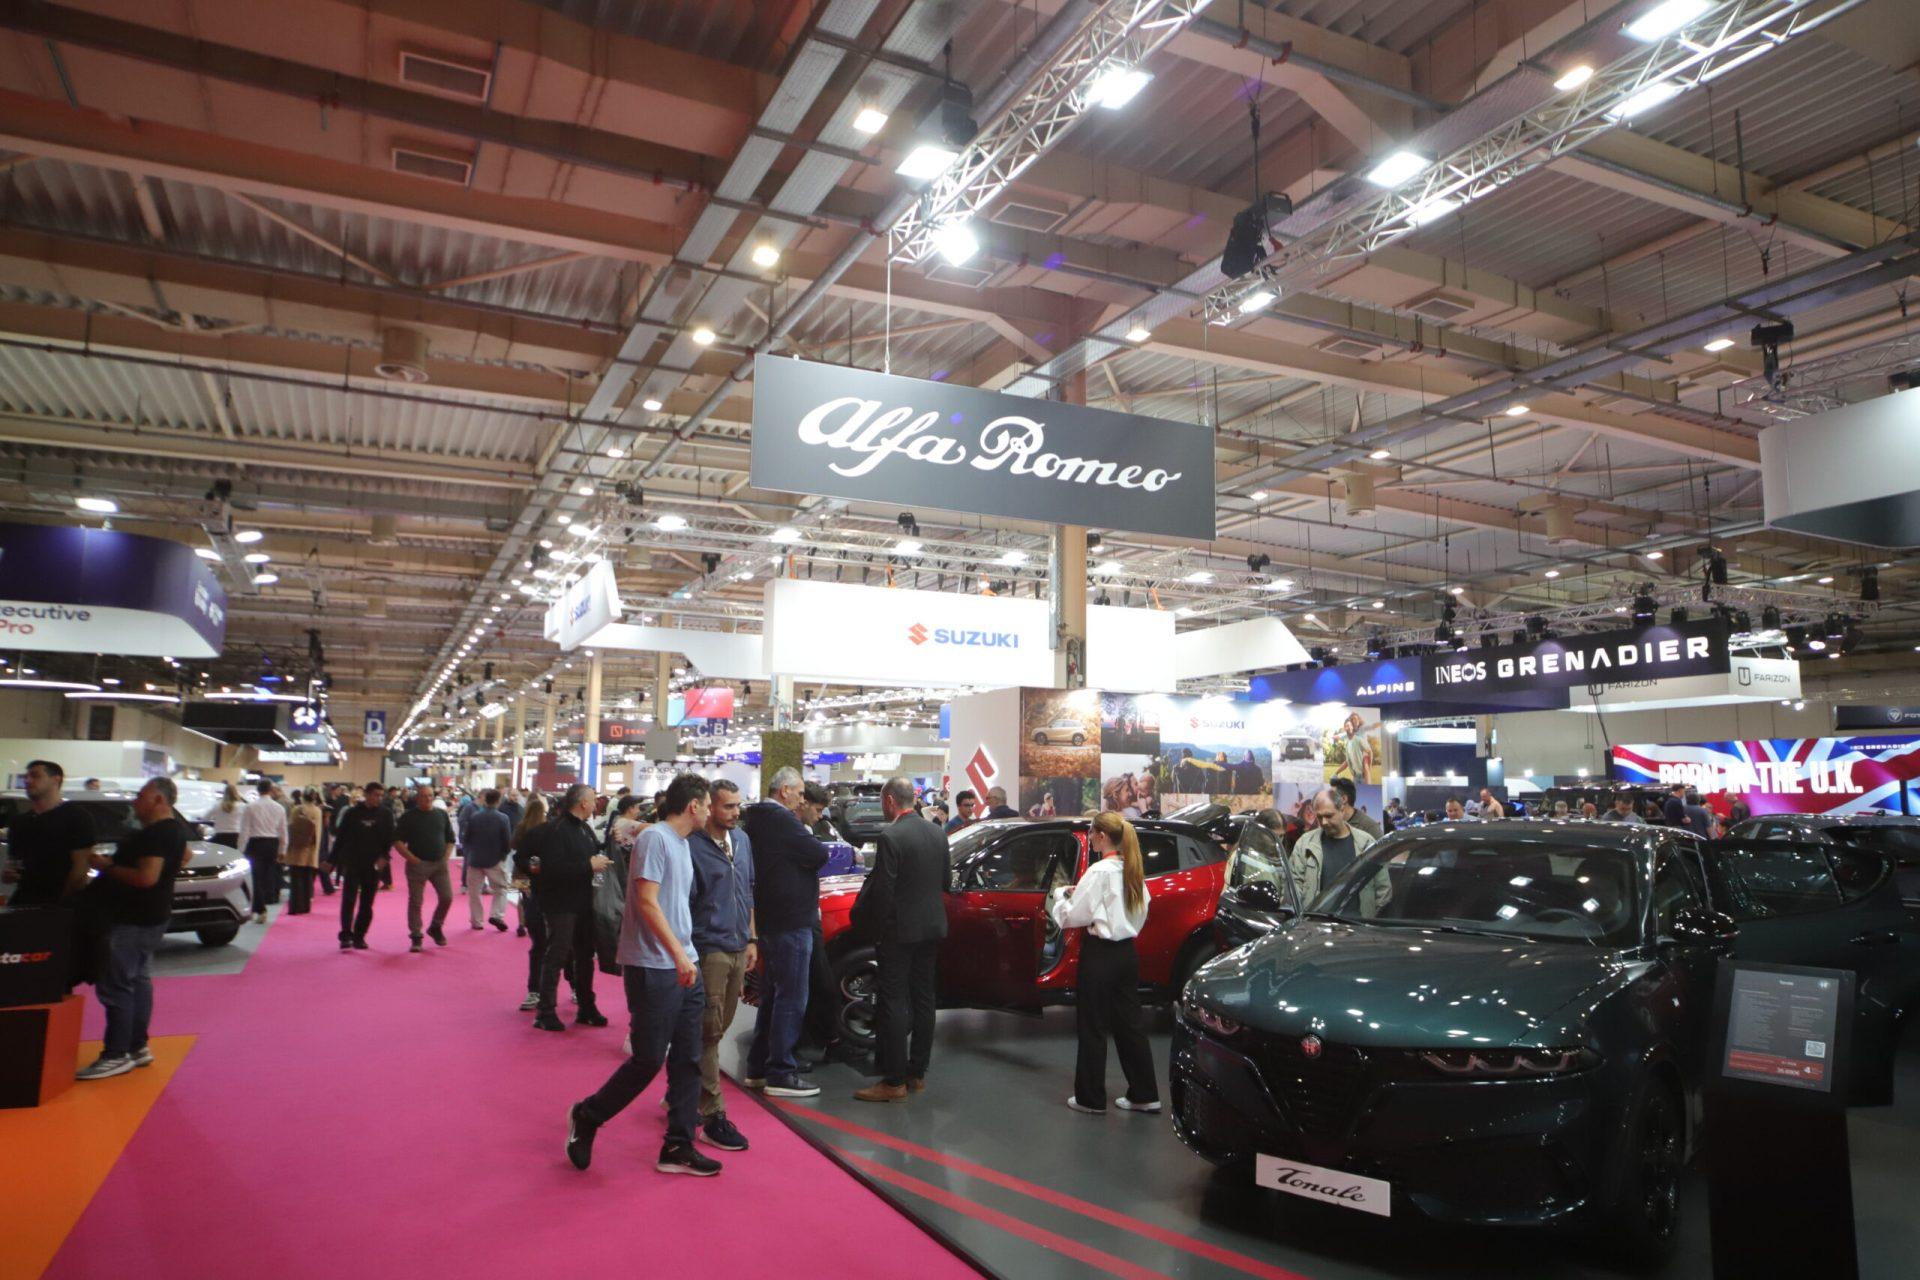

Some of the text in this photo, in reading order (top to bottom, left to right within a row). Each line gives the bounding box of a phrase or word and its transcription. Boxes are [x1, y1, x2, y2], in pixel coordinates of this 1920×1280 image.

[798, 396, 1182, 492] Alfa Romeo
[0, 604, 91, 621] ecutive
[934, 628, 1019, 648] SUZUKI
[1435, 636, 1710, 685] INEOS GRENADIER
[1754, 673, 1791, 684] FARIZON
[1356, 681, 1415, 696] ALPINE
[366, 718, 382, 734] D
[697, 722, 709, 737] C
[713, 723, 724, 735] B
[428, 739, 469, 755] Jeep
[1755, 762, 1804, 793] THE
[1809, 761, 1864, 794] U.K.
[1276, 1167, 1366, 1203] Tonale
